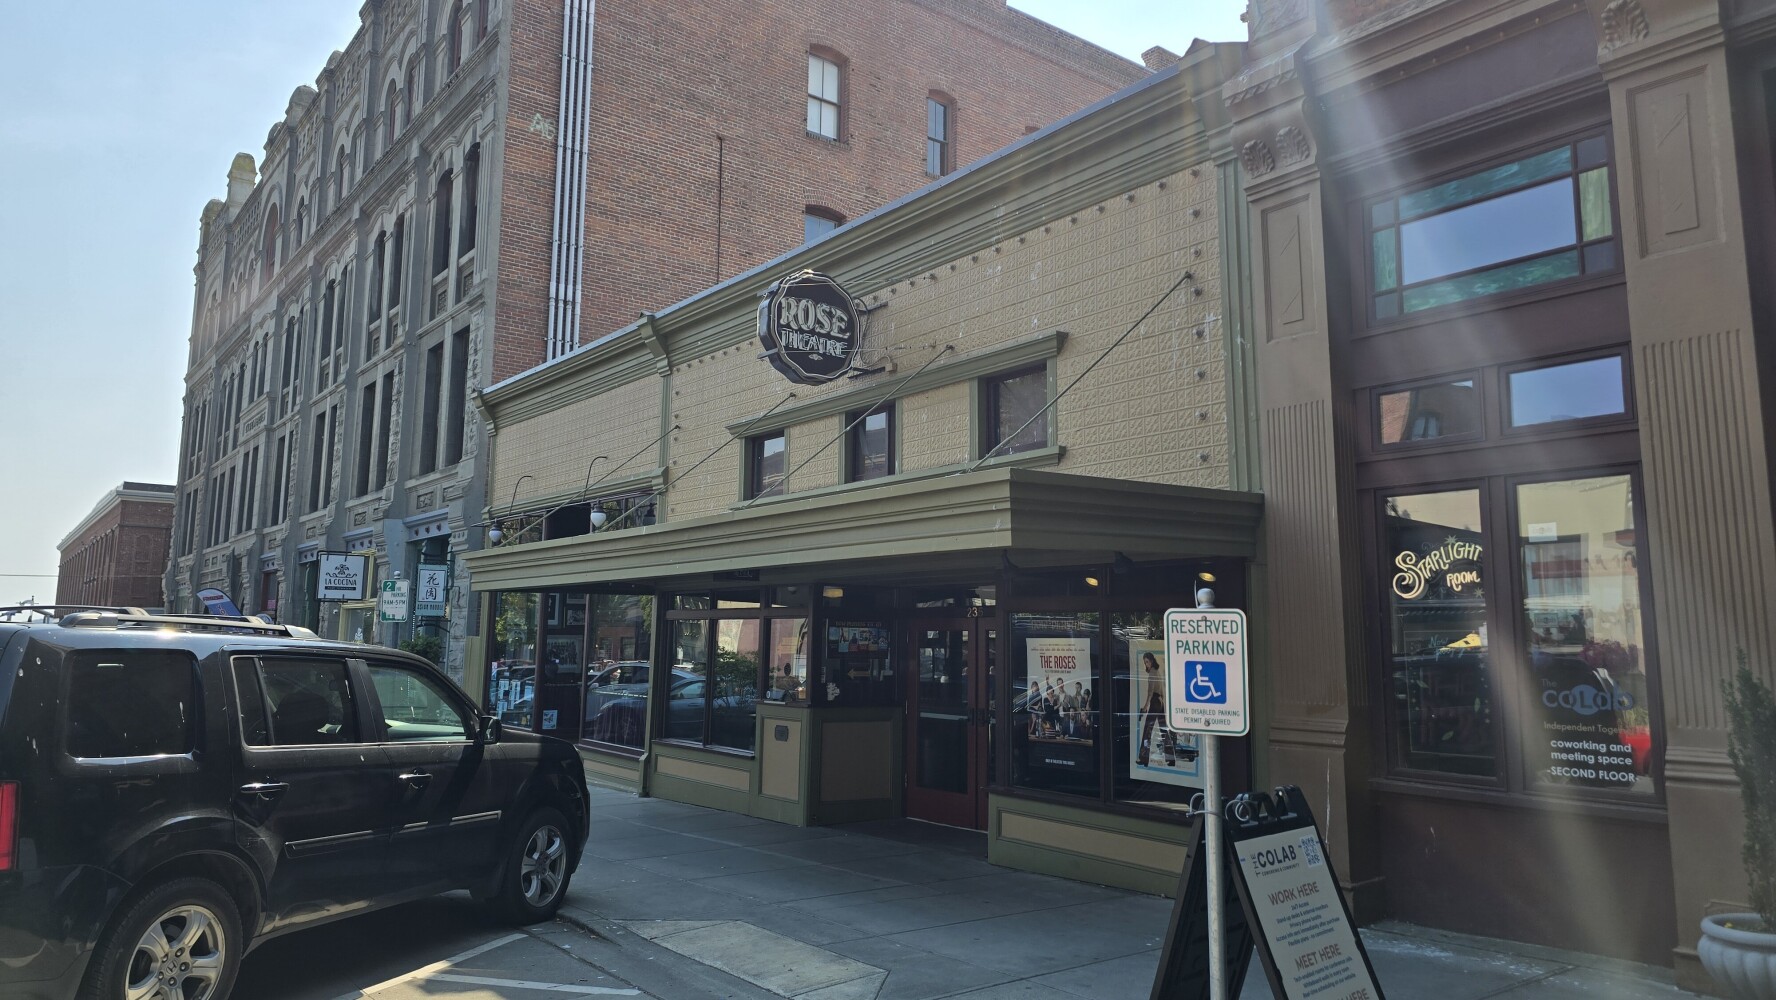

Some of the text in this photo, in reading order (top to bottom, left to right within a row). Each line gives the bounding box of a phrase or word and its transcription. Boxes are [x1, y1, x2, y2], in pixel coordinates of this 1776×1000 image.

[779, 297, 851, 338] ROSE
[780, 328, 848, 359] THEATRE
[1392, 541, 1483, 599] STARLIGHT
[325, 578, 357, 586] LA COCINA
[386, 581, 392, 590] 2
[1446, 571, 1481, 592] ROOM
[1171, 619, 1239, 635] RESERVED
[1176, 640, 1235, 656] PARKING
[1039, 655, 1077, 670] THE ROSES
[1541, 679, 1558, 687] The
[1175, 707, 1240, 717] STATE DISABLED PARKING
[1183, 716, 1202, 724] PERMIT
[1543, 721, 1595, 733] Independent
[1550, 740, 1632, 753] coworking and
[1551, 752, 1632, 765] meeting space
[1256, 844, 1297, 868] COLAB
[1268, 882, 1320, 906] WORK HERE
[1294, 943, 1342, 971] MEET HERE
